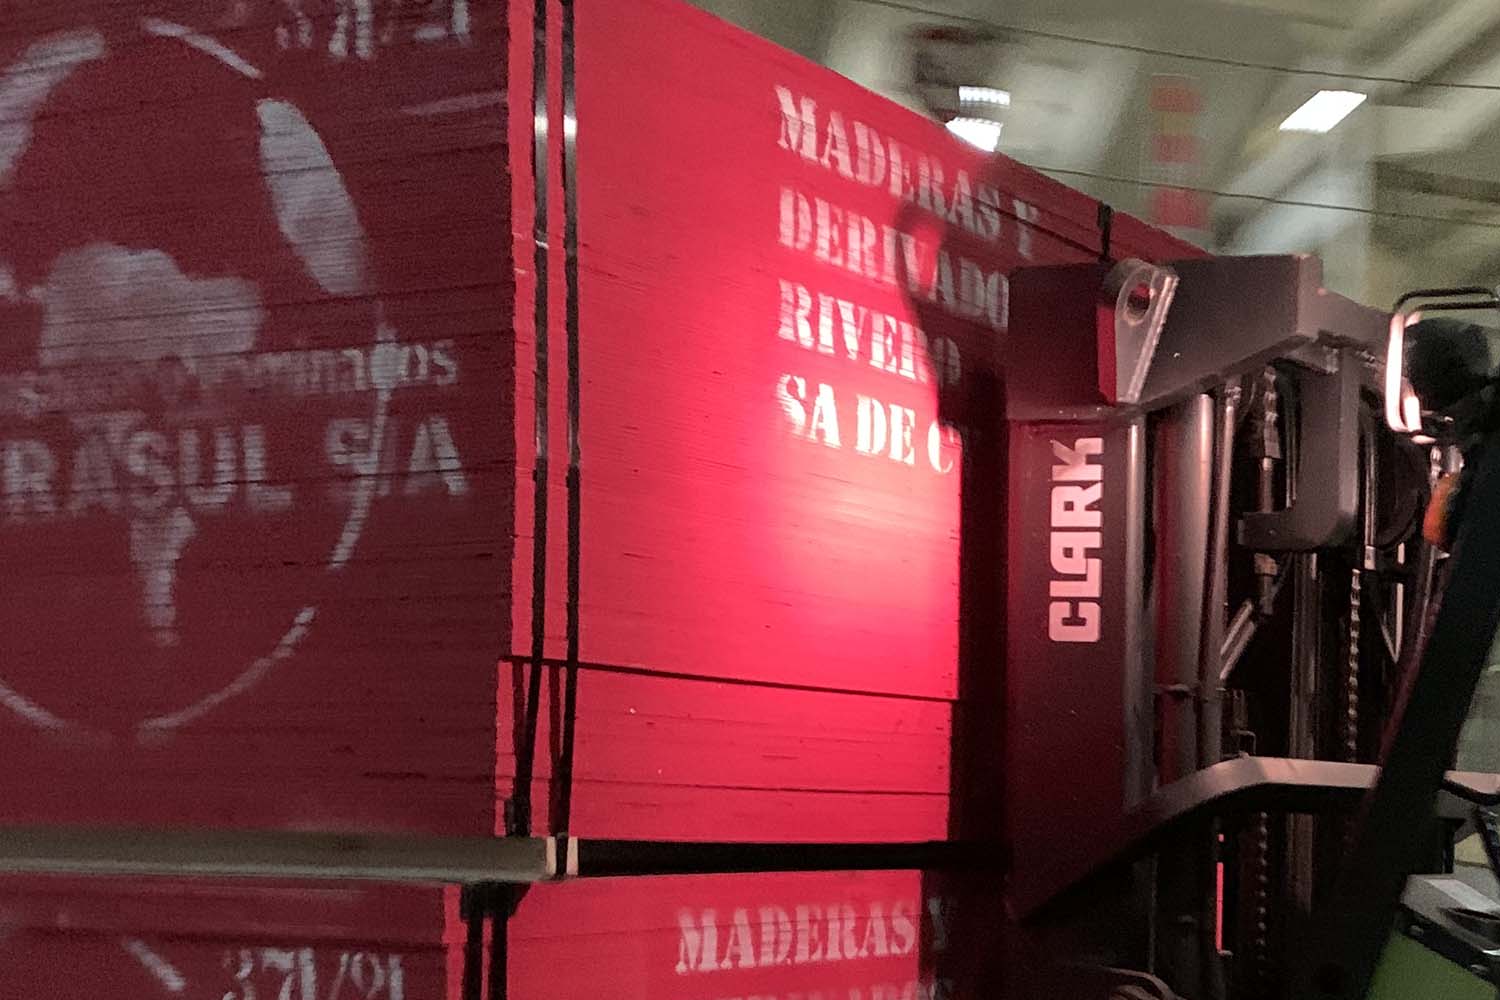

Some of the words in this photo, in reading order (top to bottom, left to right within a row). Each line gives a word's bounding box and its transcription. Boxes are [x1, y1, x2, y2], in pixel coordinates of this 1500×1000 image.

[776, 84, 1001, 243] MADERAS
[777, 374, 842, 449] SA
[856, 394, 916, 466] DE
[1049, 437, 1103, 642] CLARK
[675, 904, 917, 975] MADERAS
